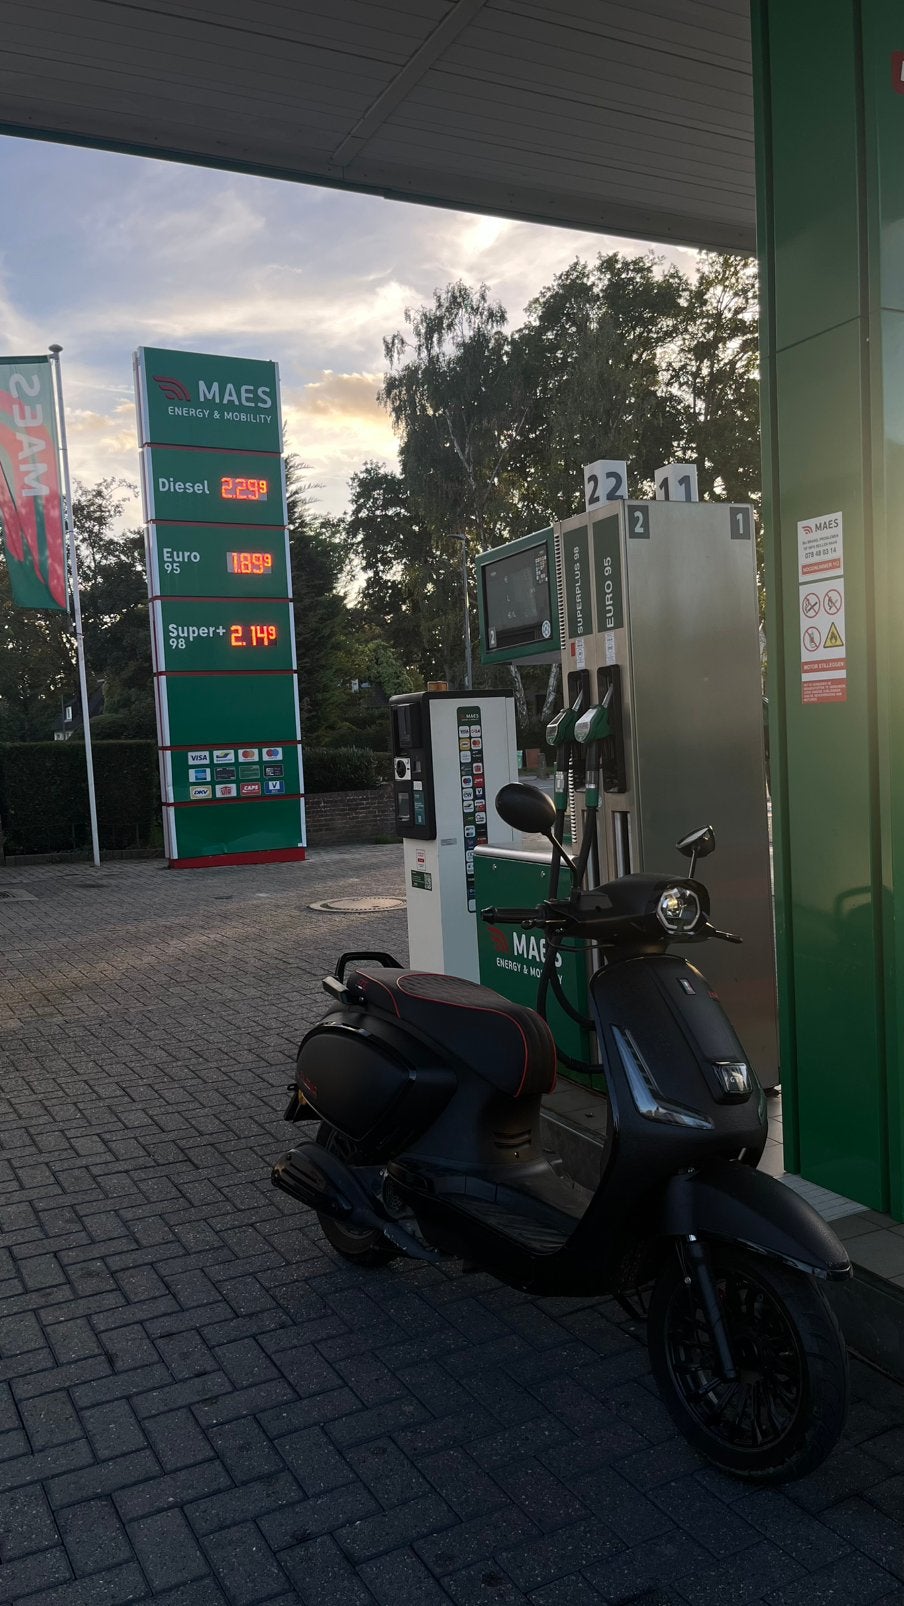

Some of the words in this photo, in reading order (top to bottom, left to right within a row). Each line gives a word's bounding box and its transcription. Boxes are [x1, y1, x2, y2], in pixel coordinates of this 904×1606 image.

[198, 380, 272, 408] MAES
[168, 406, 210, 418] ENERGY
[213, 410, 221, 419] &
[224, 411, 272, 423] MOBILITY
[158, 477, 210, 494] Diesel
[587, 474, 600, 505] 2
[605, 471, 624, 501] 2
[658, 476, 670, 501] 1
[677, 475, 692, 502] 1
[634, 510, 644, 533] 2
[736, 512, 744, 534] 1
[814, 518, 839, 532] MAES
[163, 548, 200, 562] Euro
[573, 546, 580, 560] 98
[164, 563, 181, 574] 95
[603, 556, 612, 576] 95
[573, 562, 584, 634] SUPERPLUS
[604, 580, 615, 628] EURO
[168, 623, 226, 641] Super+
[169, 638, 186, 649] 98
[496, 957, 521, 972] ENERGY
[523, 964, 529, 974] &
